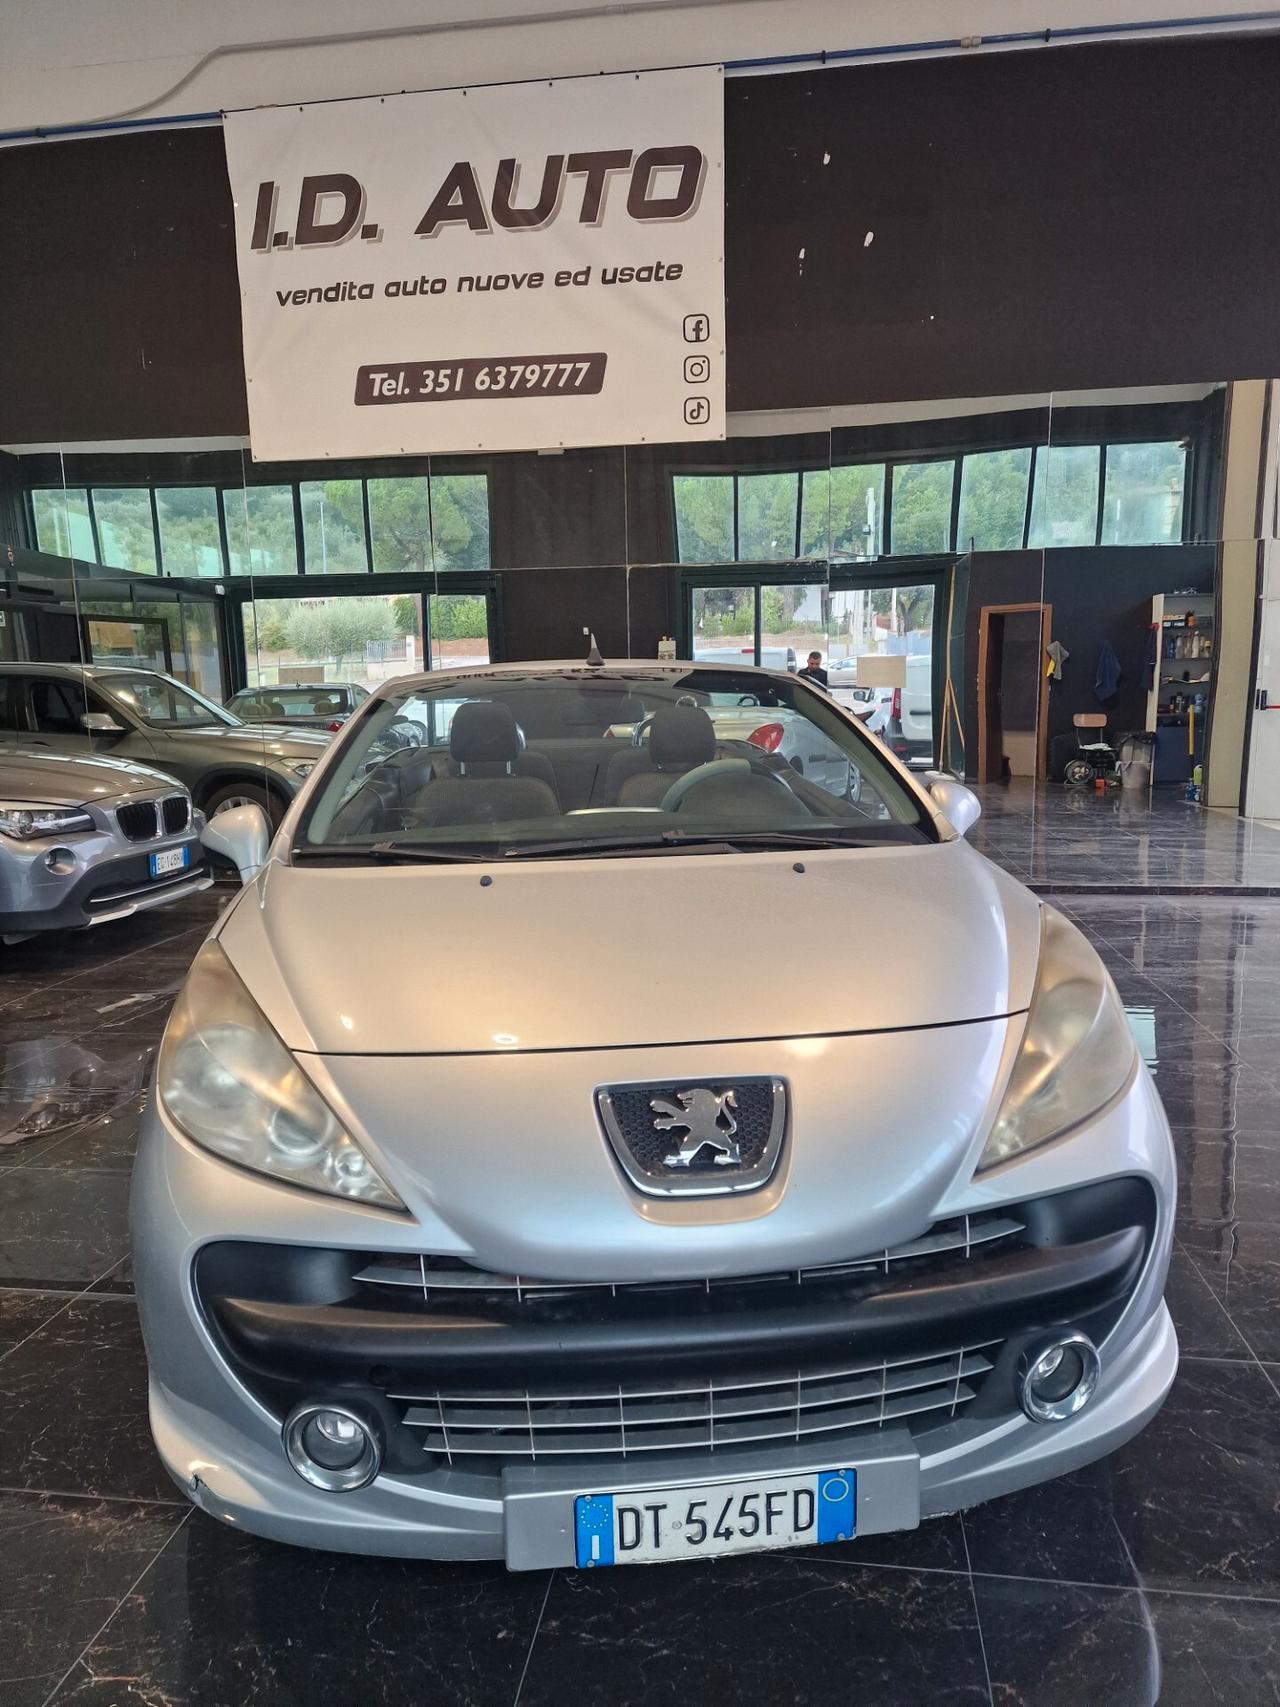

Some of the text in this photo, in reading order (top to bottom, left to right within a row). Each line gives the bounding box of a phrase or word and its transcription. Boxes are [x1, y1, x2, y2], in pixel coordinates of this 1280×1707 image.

[251, 145, 707, 252] I.D. AUTO
[276, 261, 684, 307] vendita auto nuove ed usate
[369, 362, 591, 397] Tel. 351 6379777
[617, 1503, 667, 1550] DT
[684, 1489, 815, 1545] 545FD
